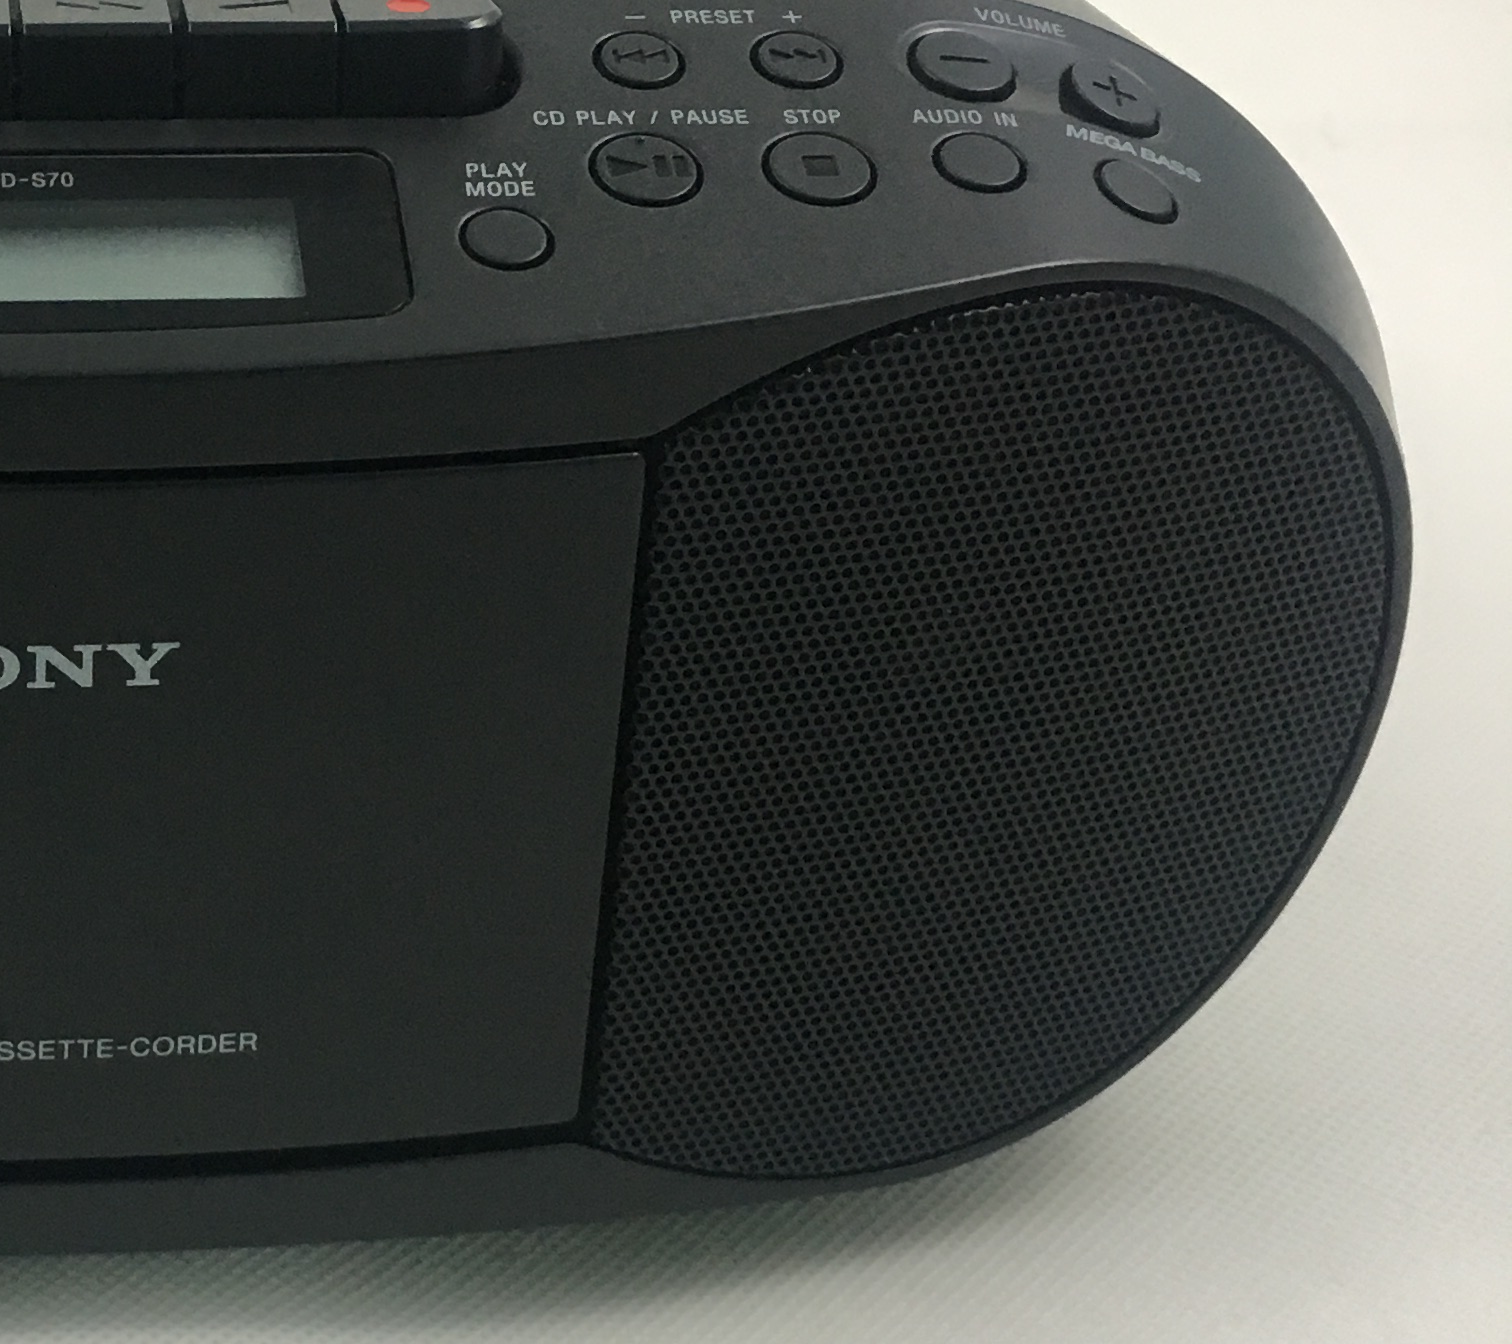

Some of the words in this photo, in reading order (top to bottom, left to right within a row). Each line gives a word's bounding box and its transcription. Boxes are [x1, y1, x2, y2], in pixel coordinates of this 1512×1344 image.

[669, 9, 755, 24] PRESET
[973, 7, 1067, 38] VOLUME
[533, 110, 565, 126] CD
[575, 109, 636, 125] PLAY
[671, 109, 750, 125] PAUSE
[783, 109, 841, 124] STOP
[912, 108, 983, 125] AUDIO
[993, 111, 1019, 127] IN
[1066, 123, 1138, 157] MEGA
[465, 161, 527, 178] PLAY
[464, 180, 536, 197] MODE
